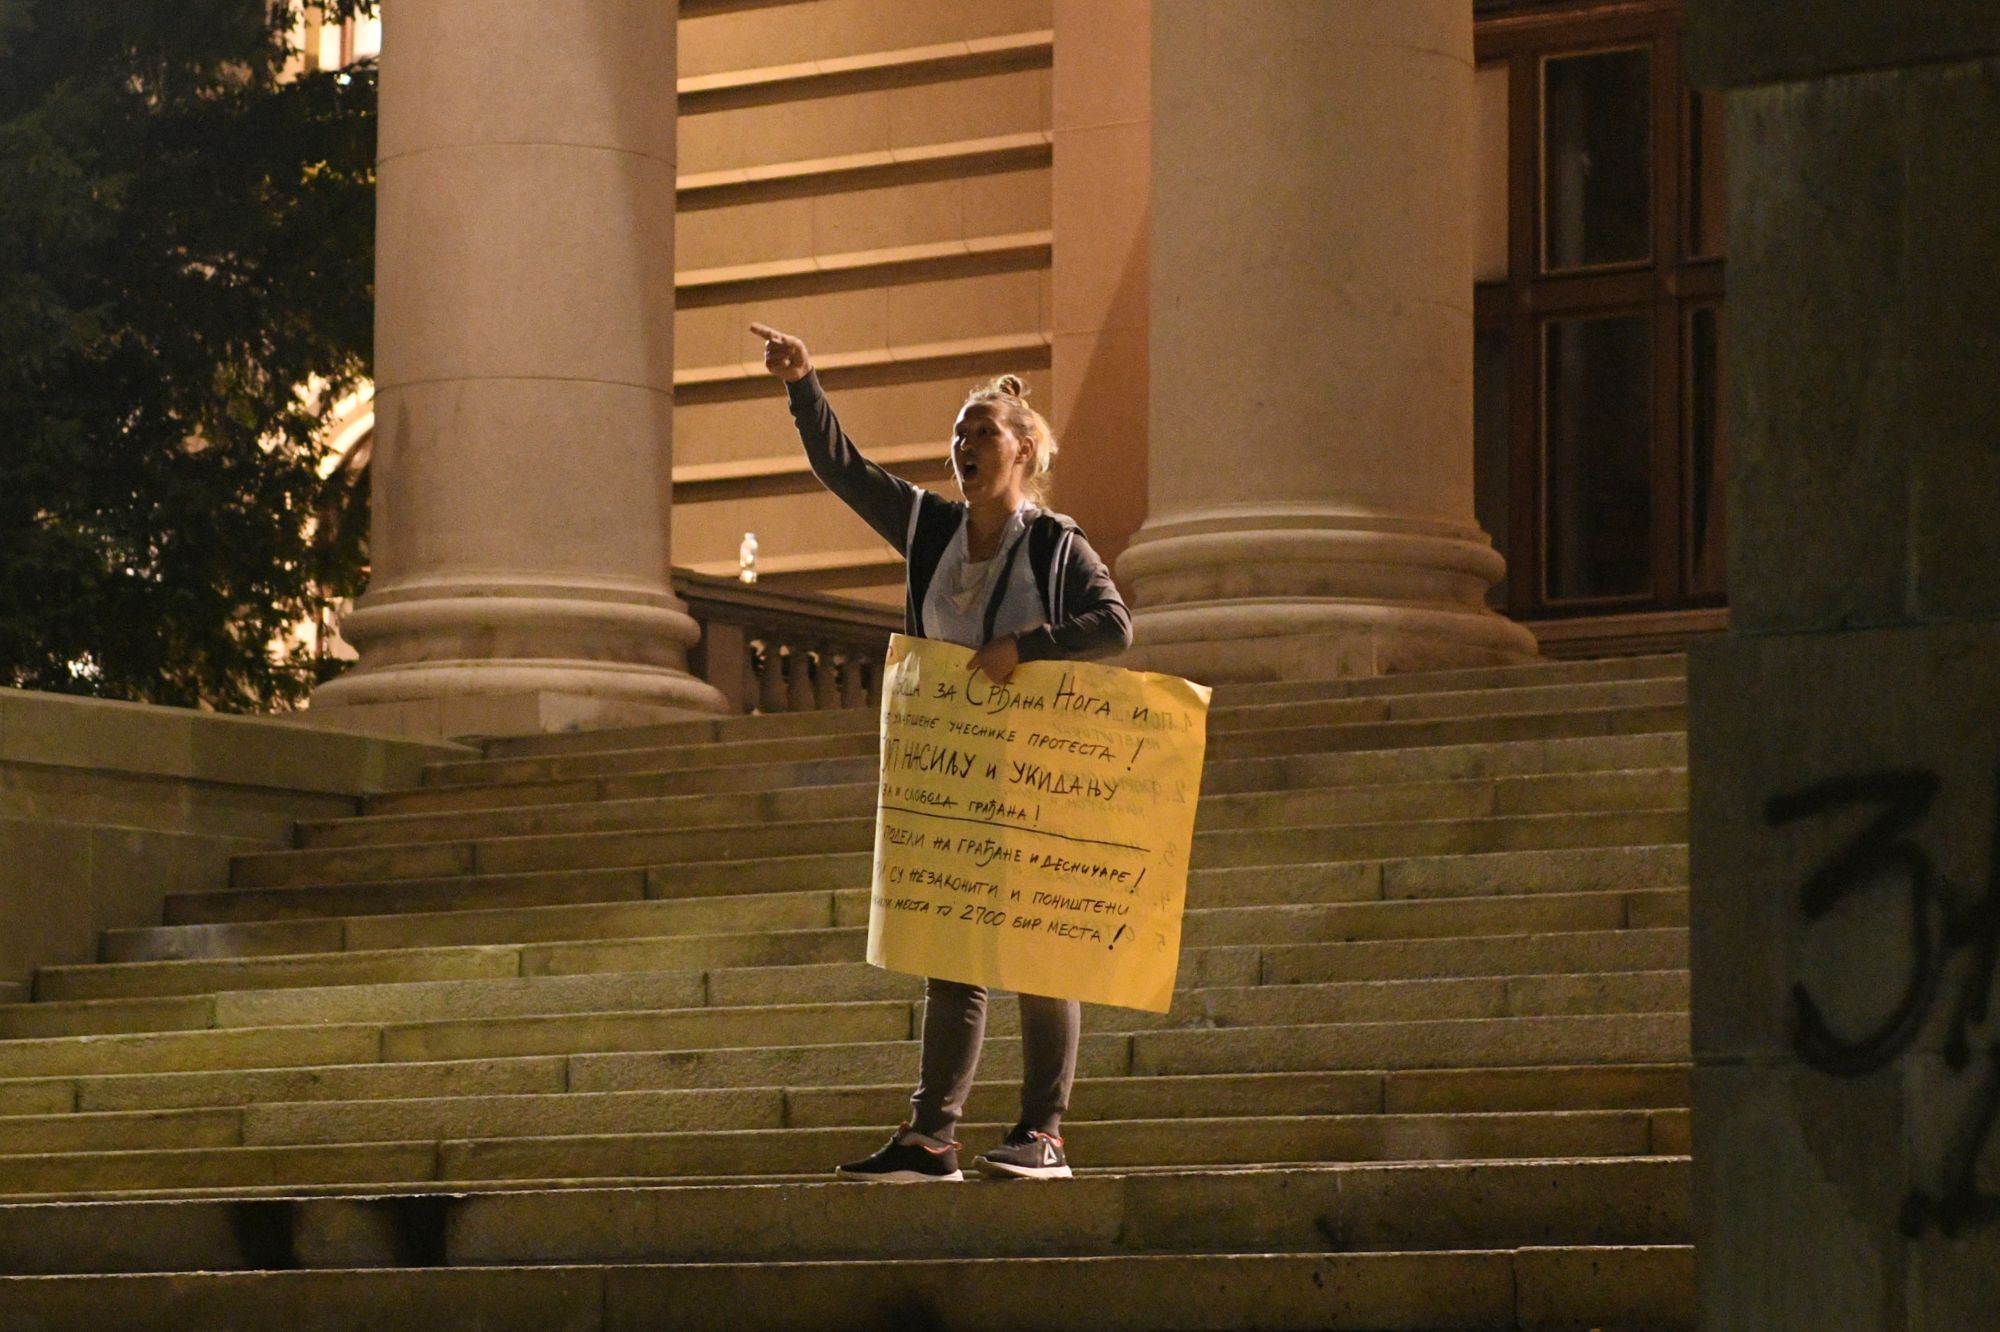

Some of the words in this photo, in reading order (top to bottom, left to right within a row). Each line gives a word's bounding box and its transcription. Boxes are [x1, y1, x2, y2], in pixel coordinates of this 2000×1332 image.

[933, 682, 957, 701] ЗА
[949, 721, 1017, 742] УЧЕСНИКЕ
[986, 765, 997, 779] И
[1009, 761, 1118, 800] УКИДАЊУ
[933, 837, 951, 850] НА
[1010, 889, 1021, 902] И
[1032, 891, 1130, 916] ПОНИШТЕНИ
[960, 904, 1007, 926] 2700
